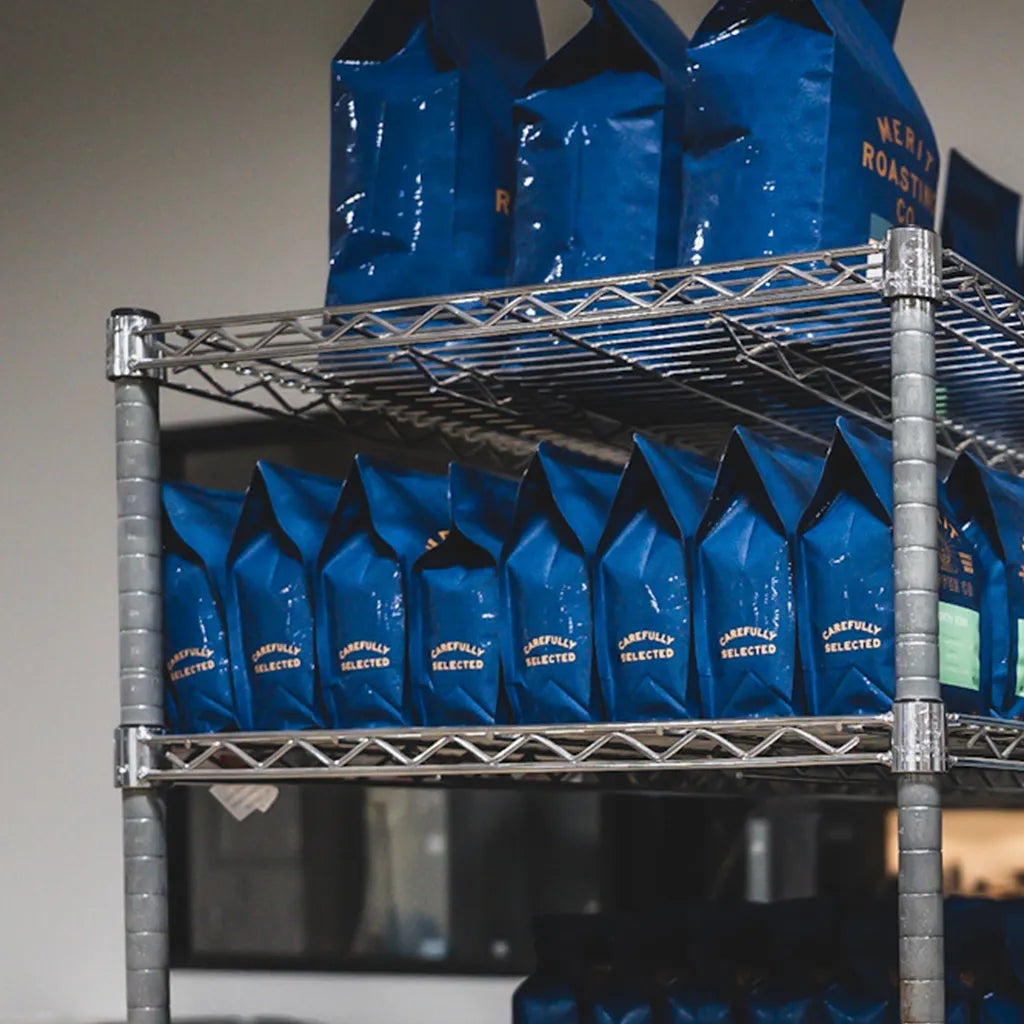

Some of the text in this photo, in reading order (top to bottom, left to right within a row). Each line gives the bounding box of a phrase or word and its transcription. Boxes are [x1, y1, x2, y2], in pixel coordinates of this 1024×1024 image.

[876, 116, 935, 172] MERIT
[719, 626, 777, 647] CAREFULLY
[822, 619, 882, 641] CAREFULLY
[339, 640, 390, 659] CAREFULLY
[431, 640, 485, 659] CAREFULLY
[524, 635, 577, 655] CAREFULLY
[618, 630, 675, 650] CAREFULLY
[825, 638, 881, 653] SELECTED
[167, 647, 214, 670] CAREFULLY
[251, 642, 301, 663] CAREFULLY
[526, 652, 577, 667] SELECTED
[620, 648, 674, 662] SELECTED
[721, 644, 776, 659] SELECTED
[170, 660, 215, 681] SELECTED
[254, 657, 301, 674] SELECTED
[341, 657, 390, 672] SELECTED
[432, 660, 484, 671] SELECTED
